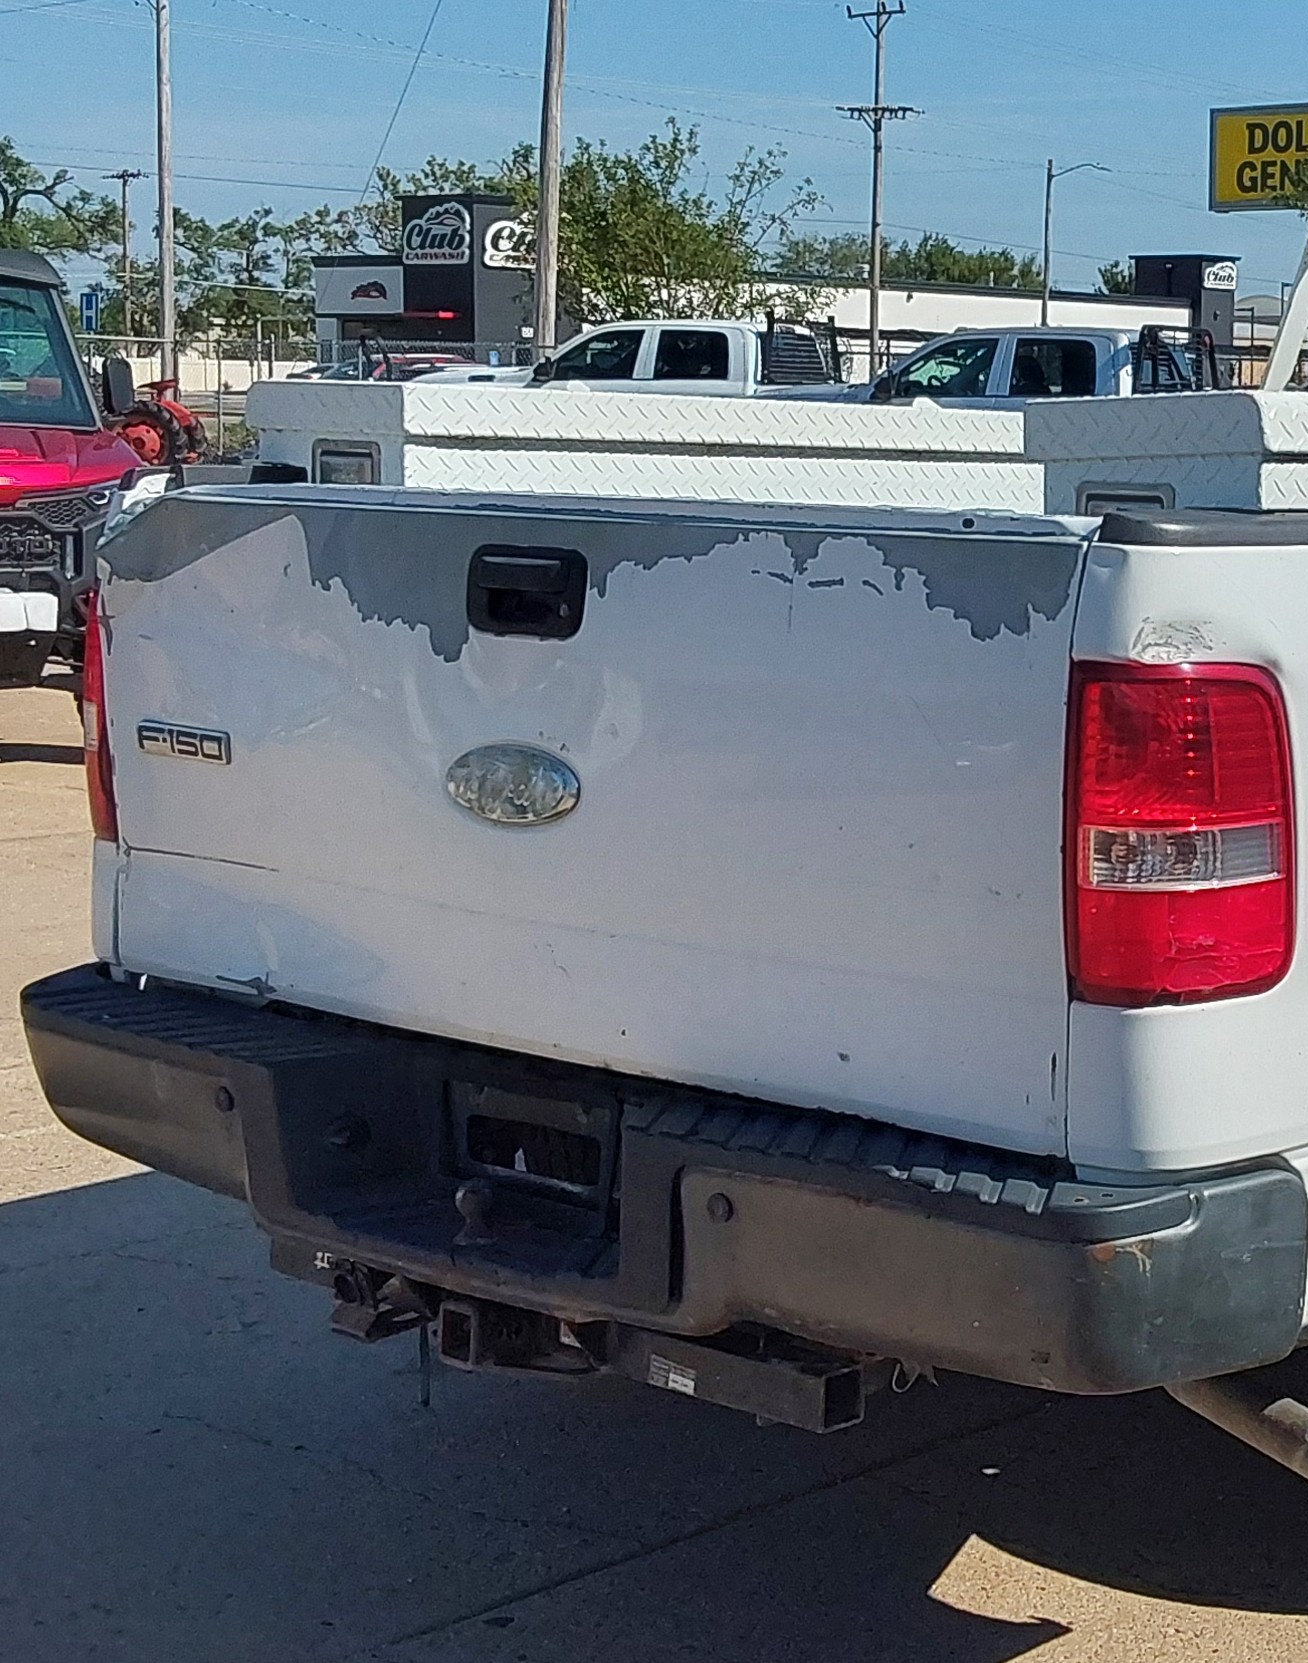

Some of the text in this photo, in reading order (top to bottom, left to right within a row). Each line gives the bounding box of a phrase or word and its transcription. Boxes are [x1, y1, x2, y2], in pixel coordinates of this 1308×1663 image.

[405, 222, 466, 250] Club
[405, 251, 465, 261] CARWASH
[1207, 270, 1234, 283] Club
[82, 295, 96, 330] H
